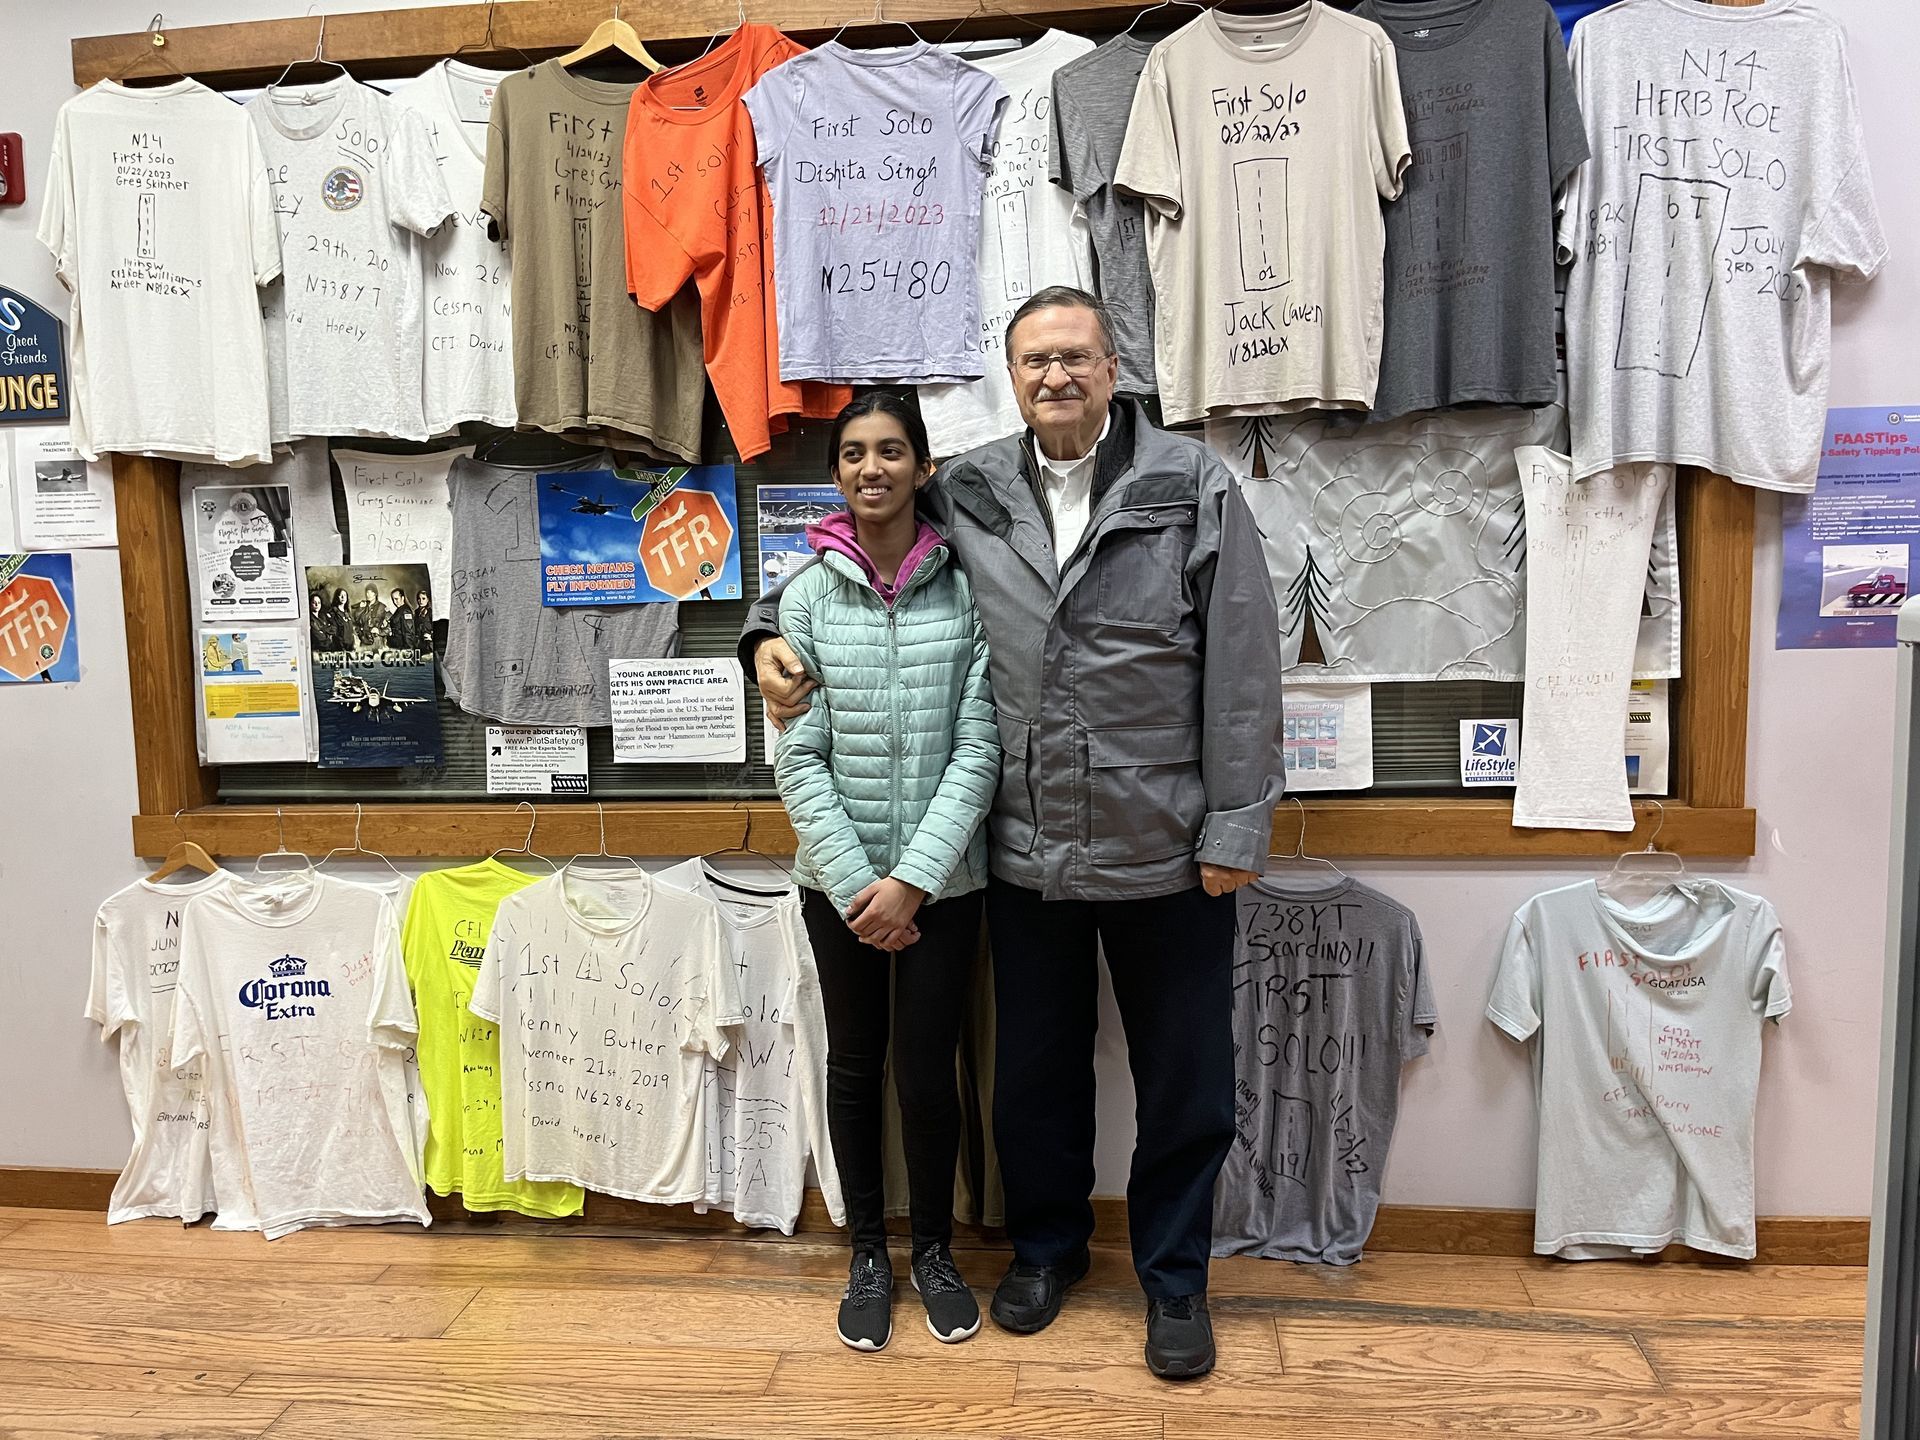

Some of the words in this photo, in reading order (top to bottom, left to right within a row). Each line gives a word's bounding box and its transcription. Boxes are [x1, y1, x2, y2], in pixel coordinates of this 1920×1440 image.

[1681, 48, 1768, 91] N14
[1212, 86, 1253, 116] First
[1260, 80, 1307, 114] Solo
[1636, 80, 1713, 118] HERB
[1723, 88, 1781, 133] ROE
[549, 112, 614, 142] First
[811, 114, 861, 140] First
[880, 109, 933, 136] Solo
[1221, 114, 1301, 145] 08/22/23
[132, 132, 162, 149] N14
[113, 152, 143, 164] First
[1613, 126, 1702, 168] FIRST
[1708, 138, 1786, 191] SOLO
[117, 166, 171, 179] 01/22/2023
[652, 160, 684, 204] 1st
[794, 158, 866, 190] Dishita
[878, 155, 937, 197] Singh
[116, 176, 142, 188] Greg
[146, 178, 190, 190] Skinner
[817, 200, 944, 234] 12/21/2023
[148, 271, 202, 288] Williams
[822, 258, 951, 300] N25480
[1258, 264, 1277, 280] 01
[1725, 258, 1754, 284] 3RD
[306, 274, 381, 307] N738YT
[433, 296, 483, 316] Cessna
[1224, 301, 1277, 336] Jack
[6, 334, 38, 351] Great
[470, 334, 504, 352] David
[1, 350, 48, 366] Friends
[1834, 432, 1908, 445] FAASTips
[1828, 448, 1860, 458] Safety
[1864, 446, 1901, 456] Tipping
[354, 466, 388, 486] First
[1532, 464, 1572, 485] First
[650, 476, 673, 502] NOTICE
[650, 513, 719, 576] TFR
[546, 565, 585, 576] CHECK
[586, 562, 635, 574] NOTAMS
[546, 581, 568, 592] FLY
[570, 578, 636, 591] INFORMED!
[647, 669, 691, 677] AEROBATIC
[505, 736, 585, 746] www.PilotSafety.org
[555, 728, 582, 736] safety?
[1465, 758, 1516, 773] LifeStyle
[454, 919, 482, 938] CFI
[1578, 949, 1642, 972] FIRST
[520, 942, 560, 976] 1st
[614, 962, 683, 1014] Solo!
[1649, 978, 1680, 989] GOAT
[1682, 976, 1706, 988] USA
[238, 978, 332, 1009] Corona
[266, 1003, 316, 1020] Extra
[520, 1009, 579, 1045] Kenny
[604, 1028, 666, 1054] Butler
[1663, 1026, 1690, 1037] C172
[1658, 1036, 1702, 1049] N738YT
[1660, 1048, 1701, 1062] 9/20/23
[632, 1070, 670, 1090] 2019
[576, 1086, 645, 1116] N62862
[1603, 1085, 1628, 1102] CFI
[1656, 1095, 1690, 1112] Perry
[531, 1116, 561, 1127] David
[572, 1126, 618, 1149] Hopely
